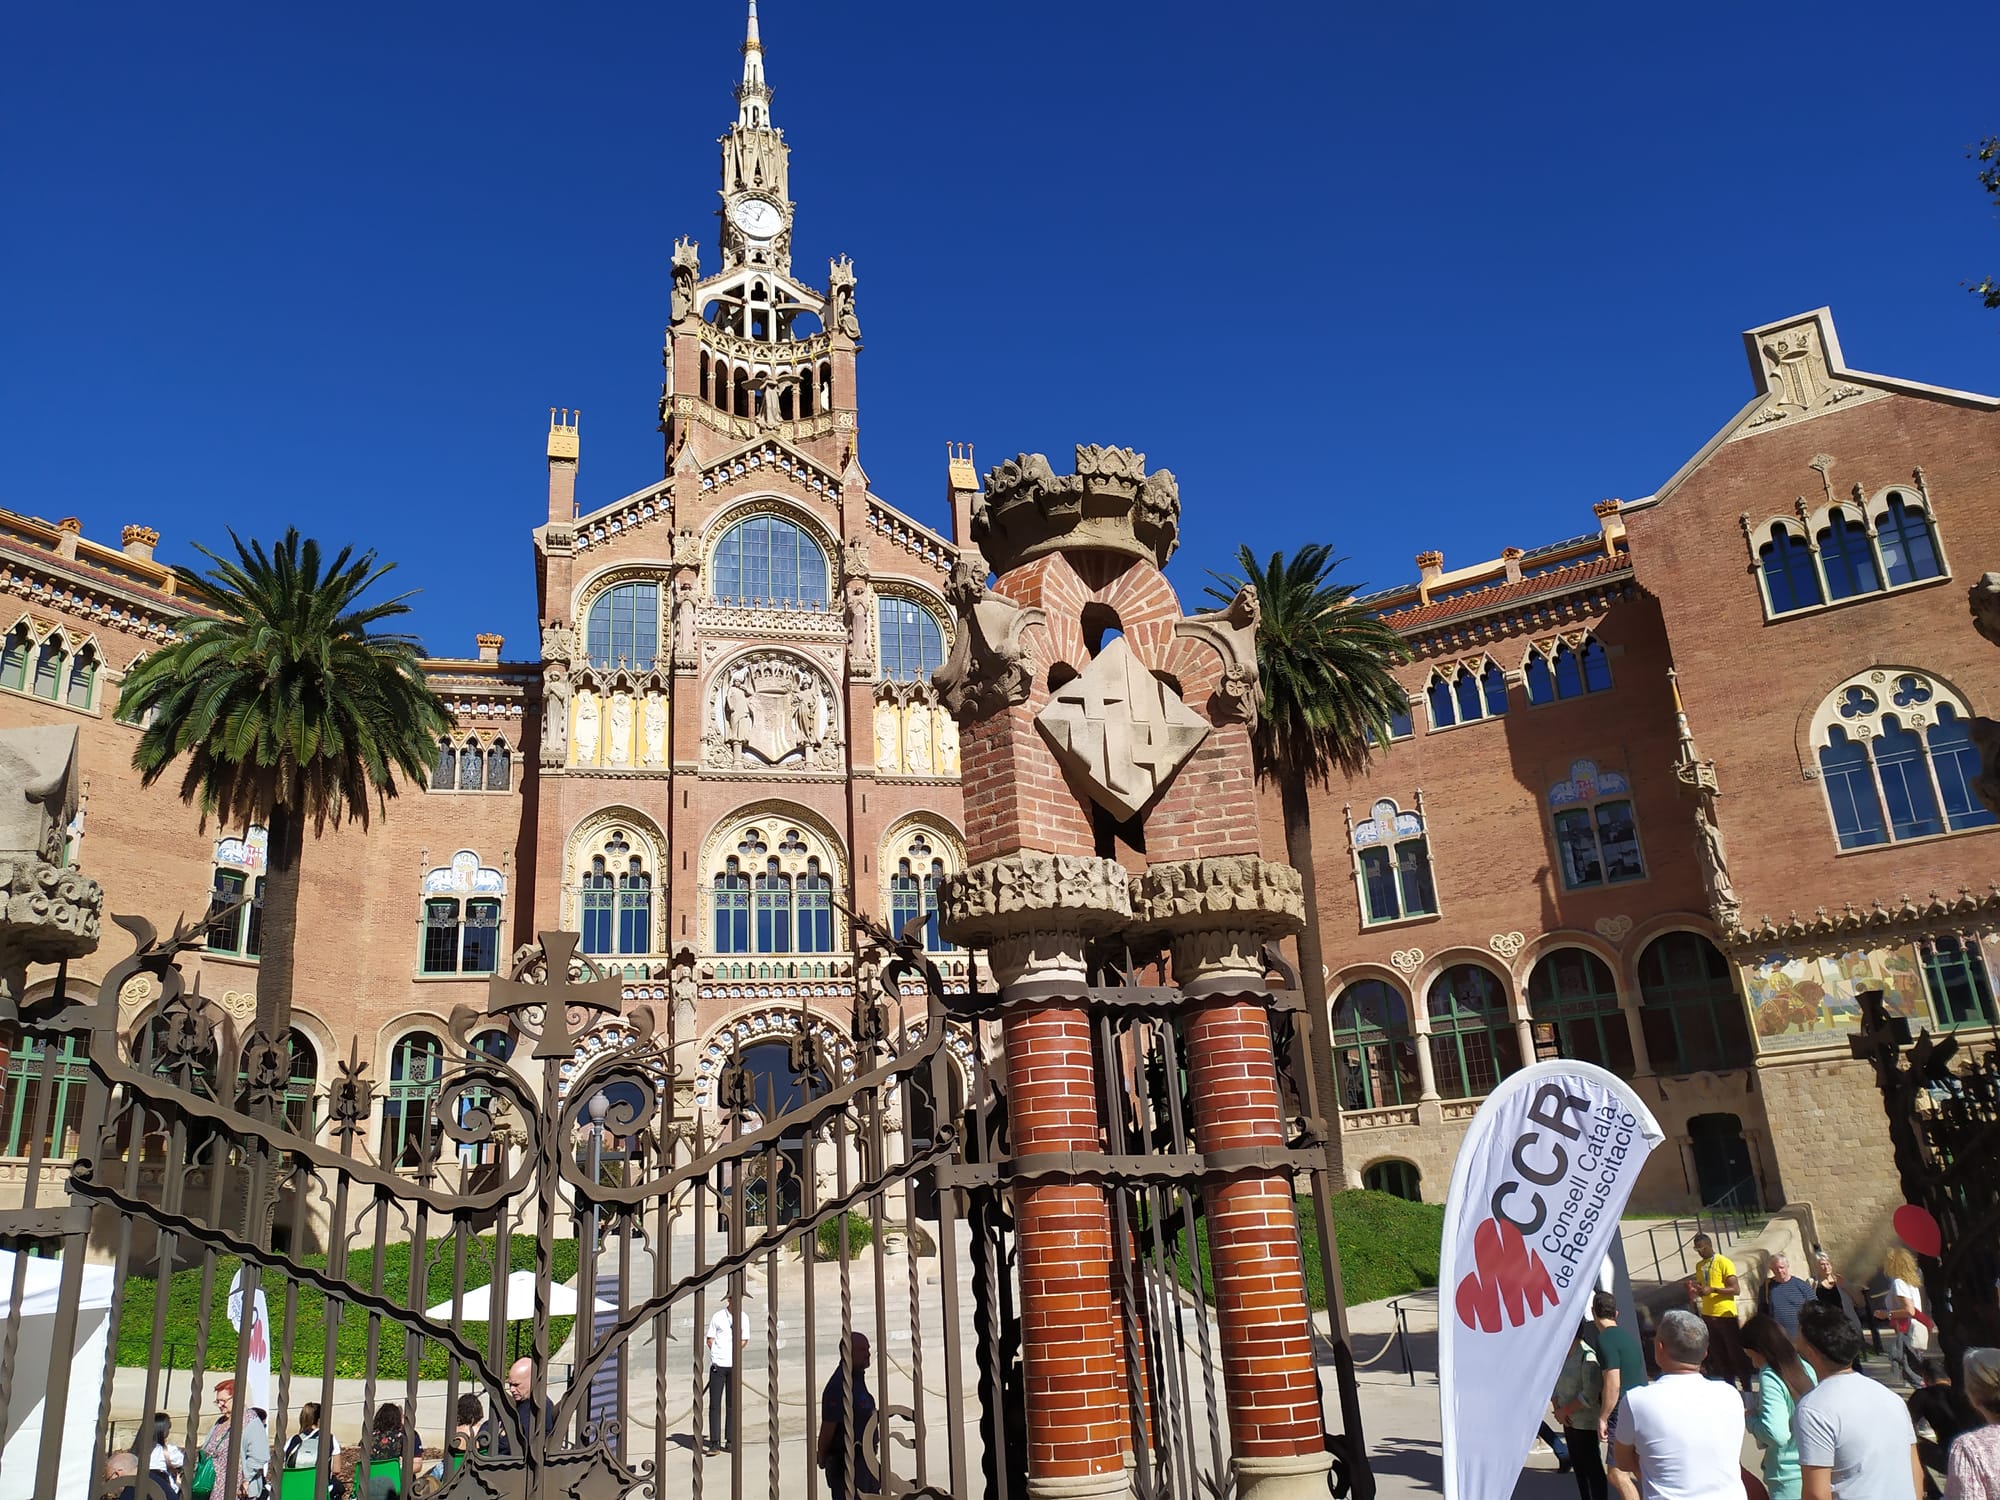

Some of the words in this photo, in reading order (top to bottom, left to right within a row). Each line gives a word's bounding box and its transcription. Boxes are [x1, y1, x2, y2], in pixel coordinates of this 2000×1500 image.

[1491, 1083, 1592, 1236] CCR
[1542, 1175, 1590, 1253] Consell
[1578, 1105, 1616, 1173] Català
[1560, 1113, 1637, 1265] Ressuscitació
[1554, 1264, 1575, 1289] de
